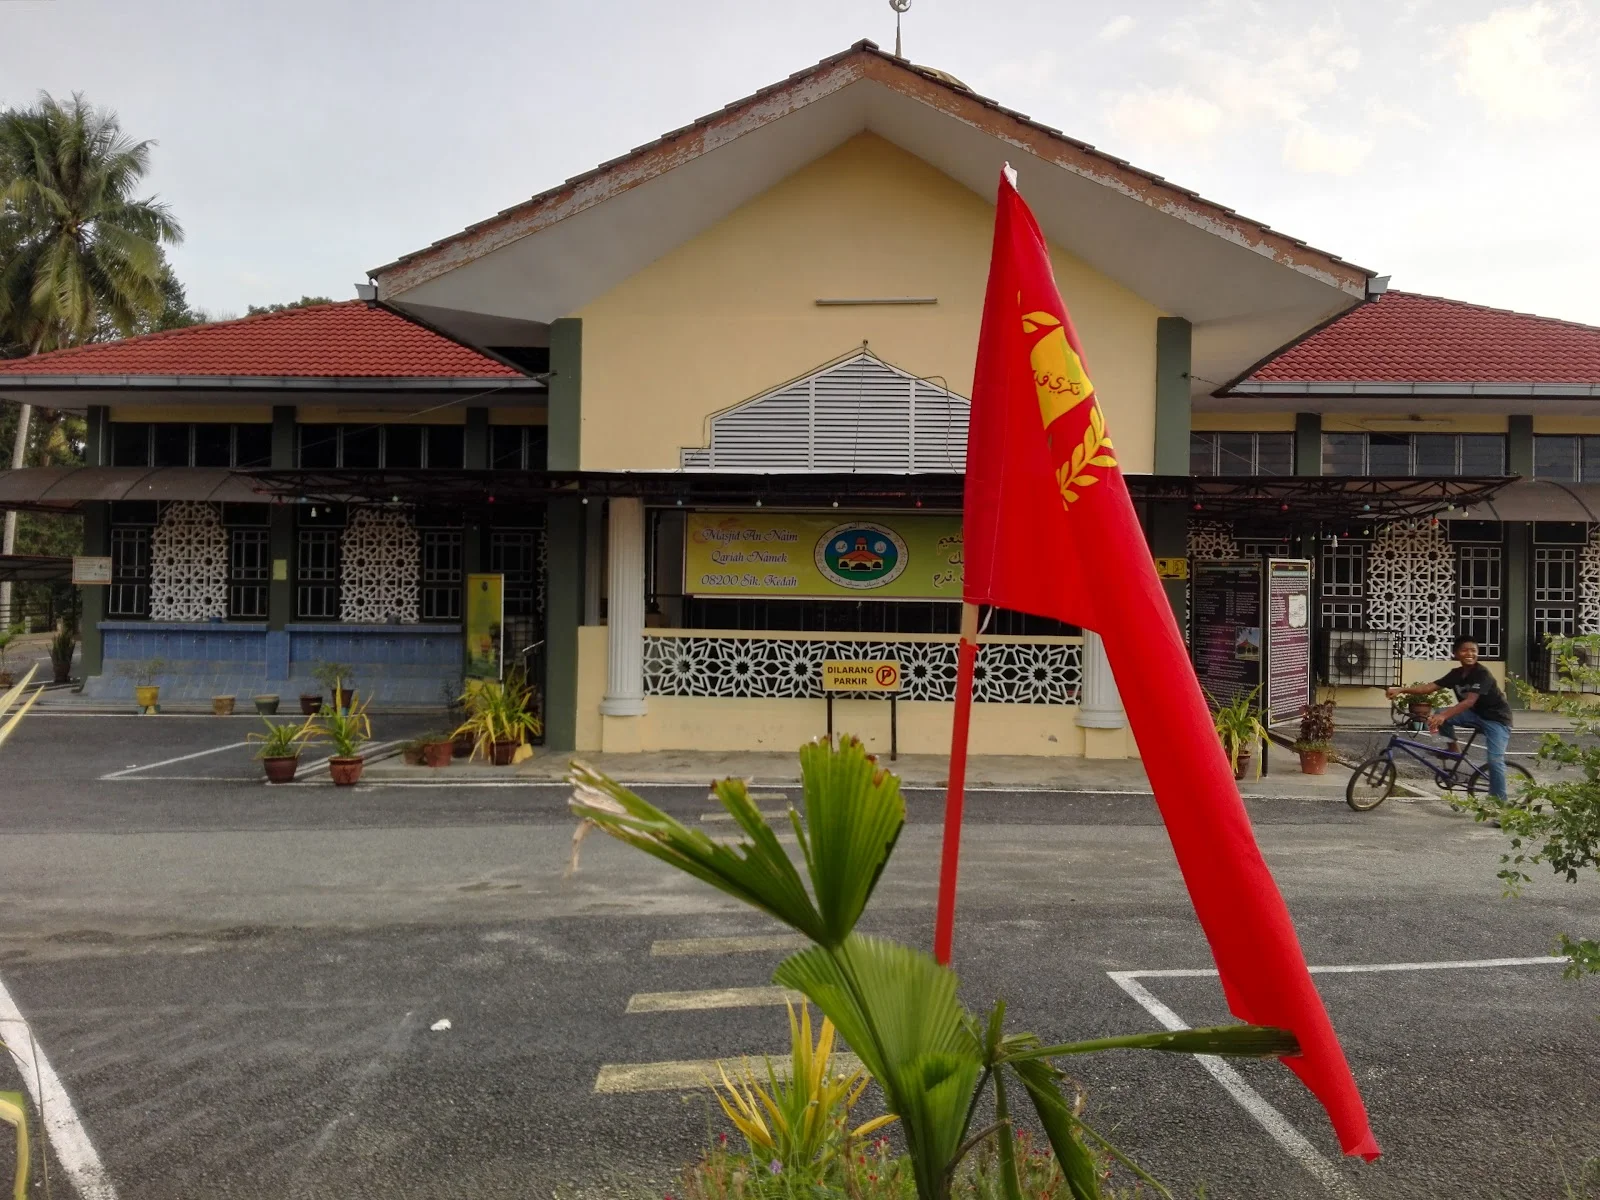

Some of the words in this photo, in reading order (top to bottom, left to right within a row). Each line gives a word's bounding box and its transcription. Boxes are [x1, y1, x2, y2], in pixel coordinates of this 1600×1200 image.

[702, 528, 740, 545] Masjid
[743, 529, 761, 541] An
[764, 529, 798, 541] Naim
[937, 528, 964, 555] لنعيم
[711, 550, 744, 565] Qariah
[746, 551, 788, 563] Namek
[701, 574, 738, 586] 08200
[764, 574, 797, 587] Kedah
